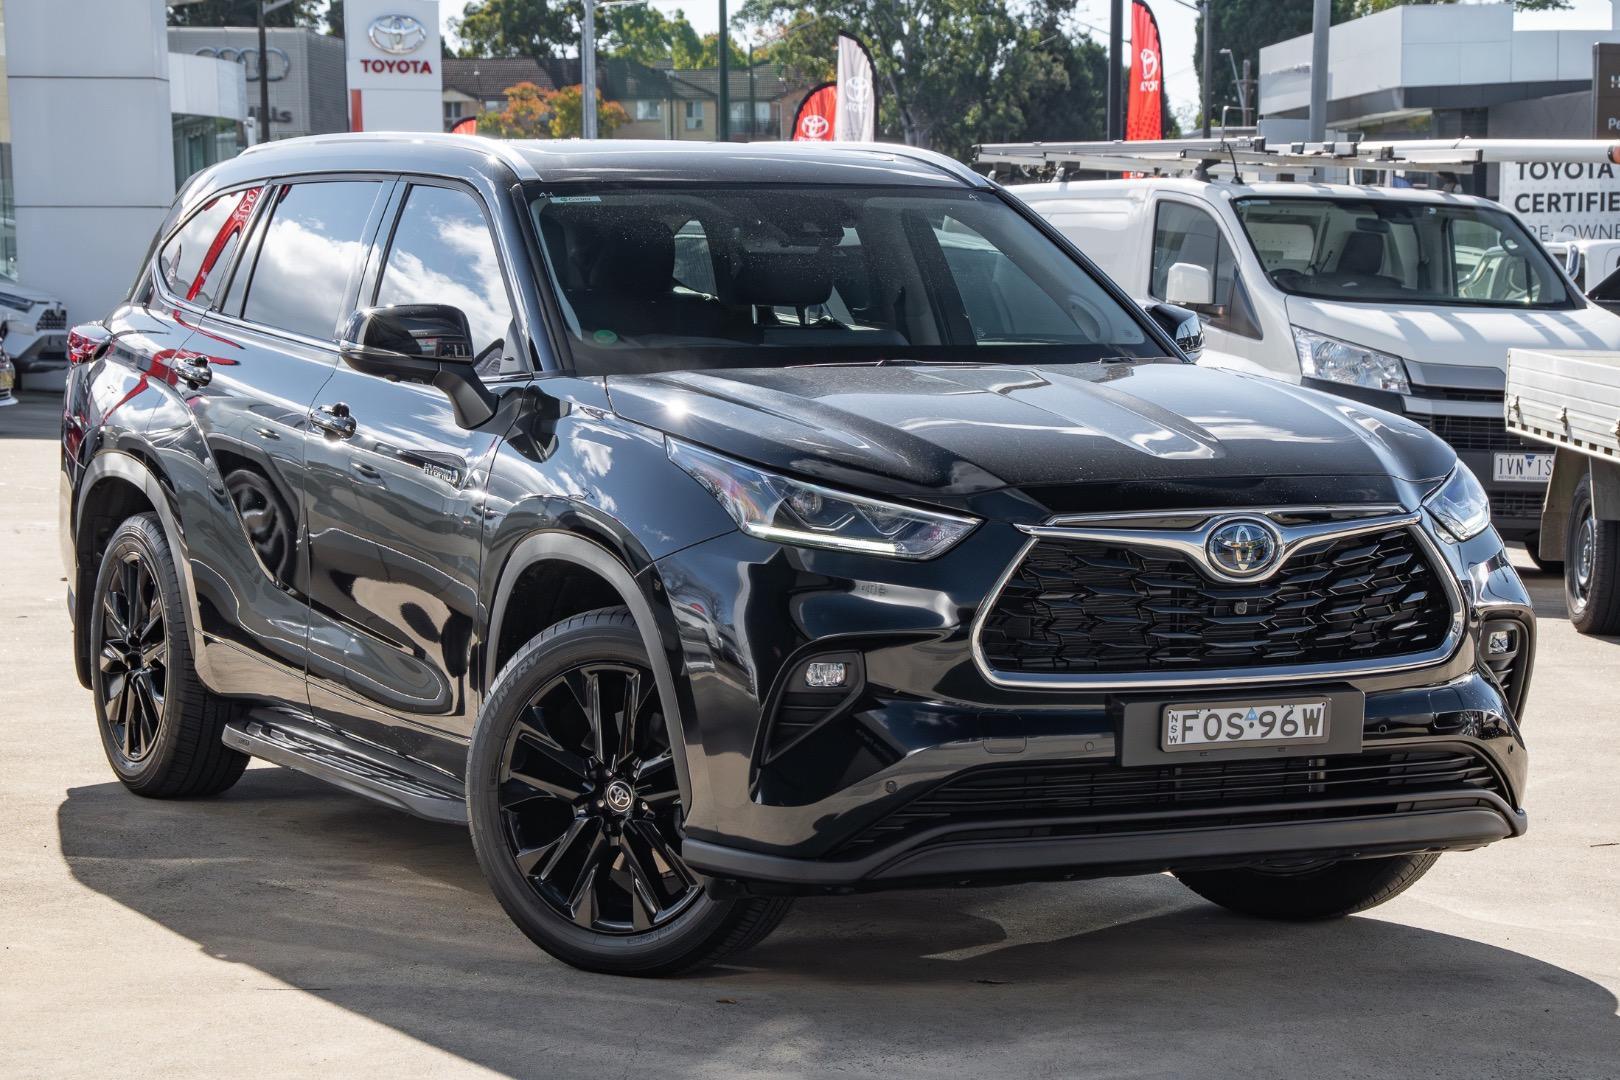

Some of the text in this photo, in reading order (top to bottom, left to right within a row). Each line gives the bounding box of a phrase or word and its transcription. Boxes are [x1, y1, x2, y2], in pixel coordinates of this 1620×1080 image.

[360, 59, 432, 74] TOYOTA
[1515, 161, 1614, 180] TOYOTA
[1499, 458, 1524, 475] 1VN
